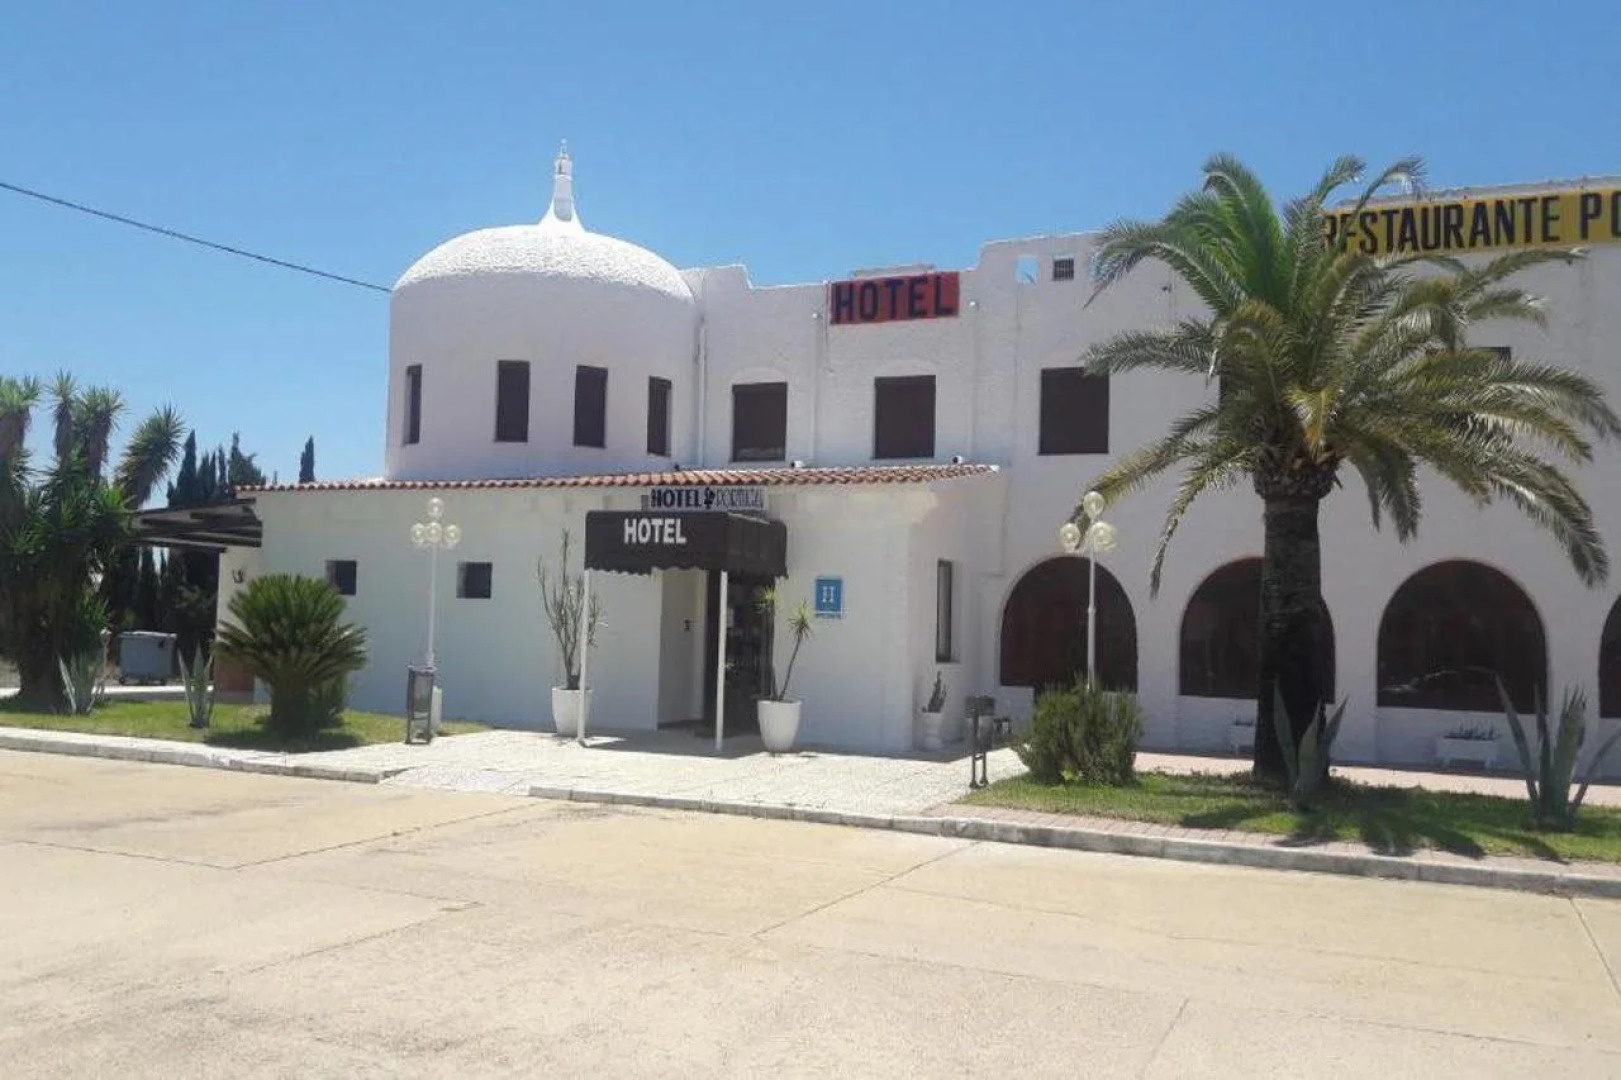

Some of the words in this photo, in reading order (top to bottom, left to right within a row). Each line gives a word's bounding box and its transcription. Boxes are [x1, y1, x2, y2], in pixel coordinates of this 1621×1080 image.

[1323, 195, 1560, 254] RESTAURANTE
[835, 274, 955, 323] HOTEL
[651, 489, 702, 508] HOTEL
[623, 518, 687, 544] HOTEL
